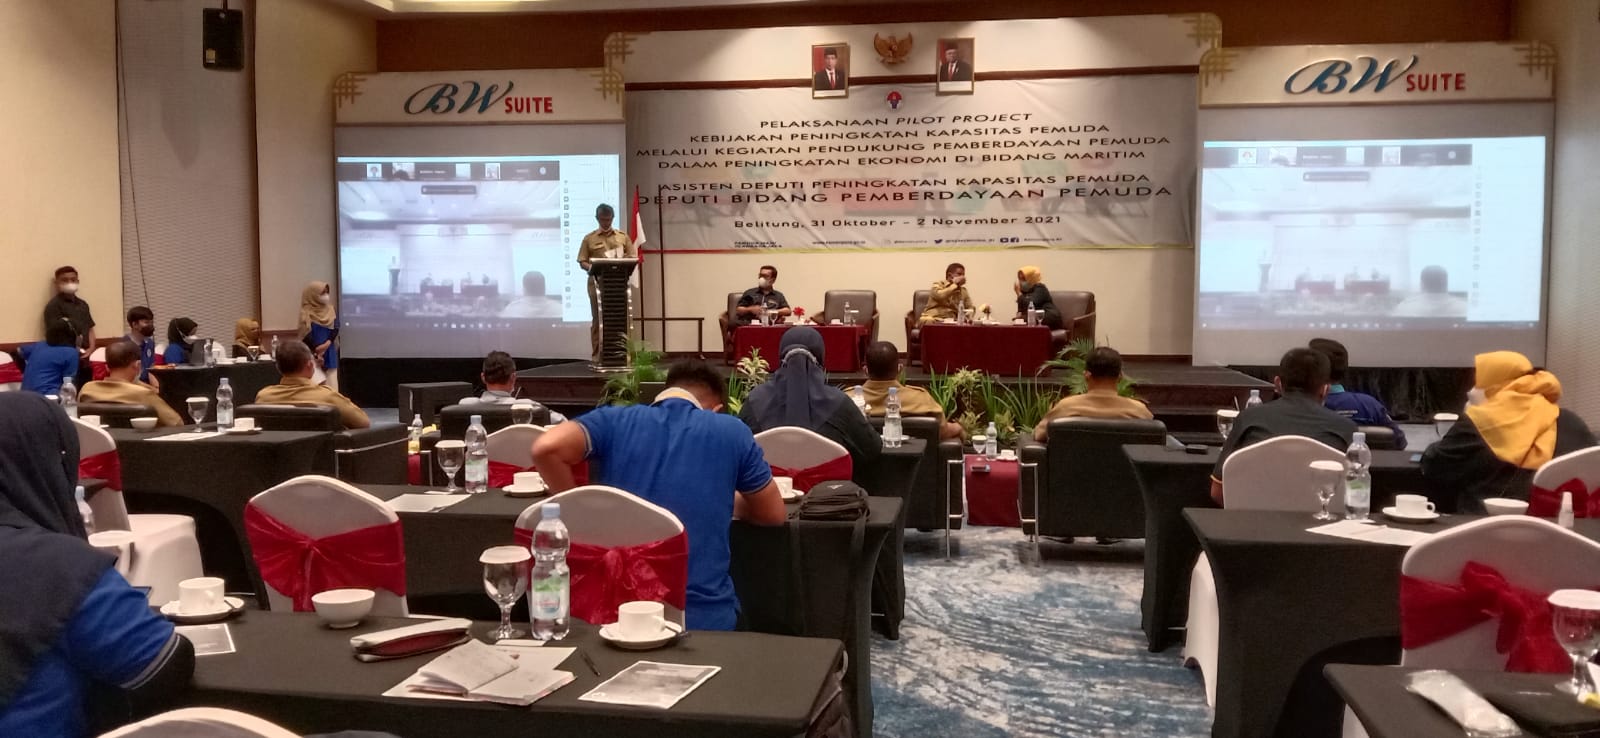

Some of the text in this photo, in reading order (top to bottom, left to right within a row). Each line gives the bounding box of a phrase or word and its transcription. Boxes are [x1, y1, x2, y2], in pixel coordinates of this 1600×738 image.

[1406, 73, 1466, 92] SUITE
[504, 97, 553, 114] SUITE
[760, 113, 1032, 128] PELAKSANAAN PILOT PROJECT
[690, 125, 1110, 143] KEBIJAKAN PENINGKATAN KAPASITAS PEMUDA
[636, 136, 1170, 157] MELALUI KEGIATAN PENDUKUNG PEMBERDAYAAN PEMUDA
[659, 151, 1145, 169] DALAM PENINGKATAN EKONOMI DI BIDANG MARITIM
[661, 174, 1150, 191] ASISTEN DEPUTI PENINGKATAN KAPASITAS PEMUDA
[731, 193, 828, 204] BIDANG
[841, 189, 1044, 202] PEMBERDAYAAN
[1059, 186, 1172, 198] PEMUDA
[832, 219, 896, 227] Oktober
[932, 216, 1018, 225] November
[1025, 216, 1061, 224] 2021
